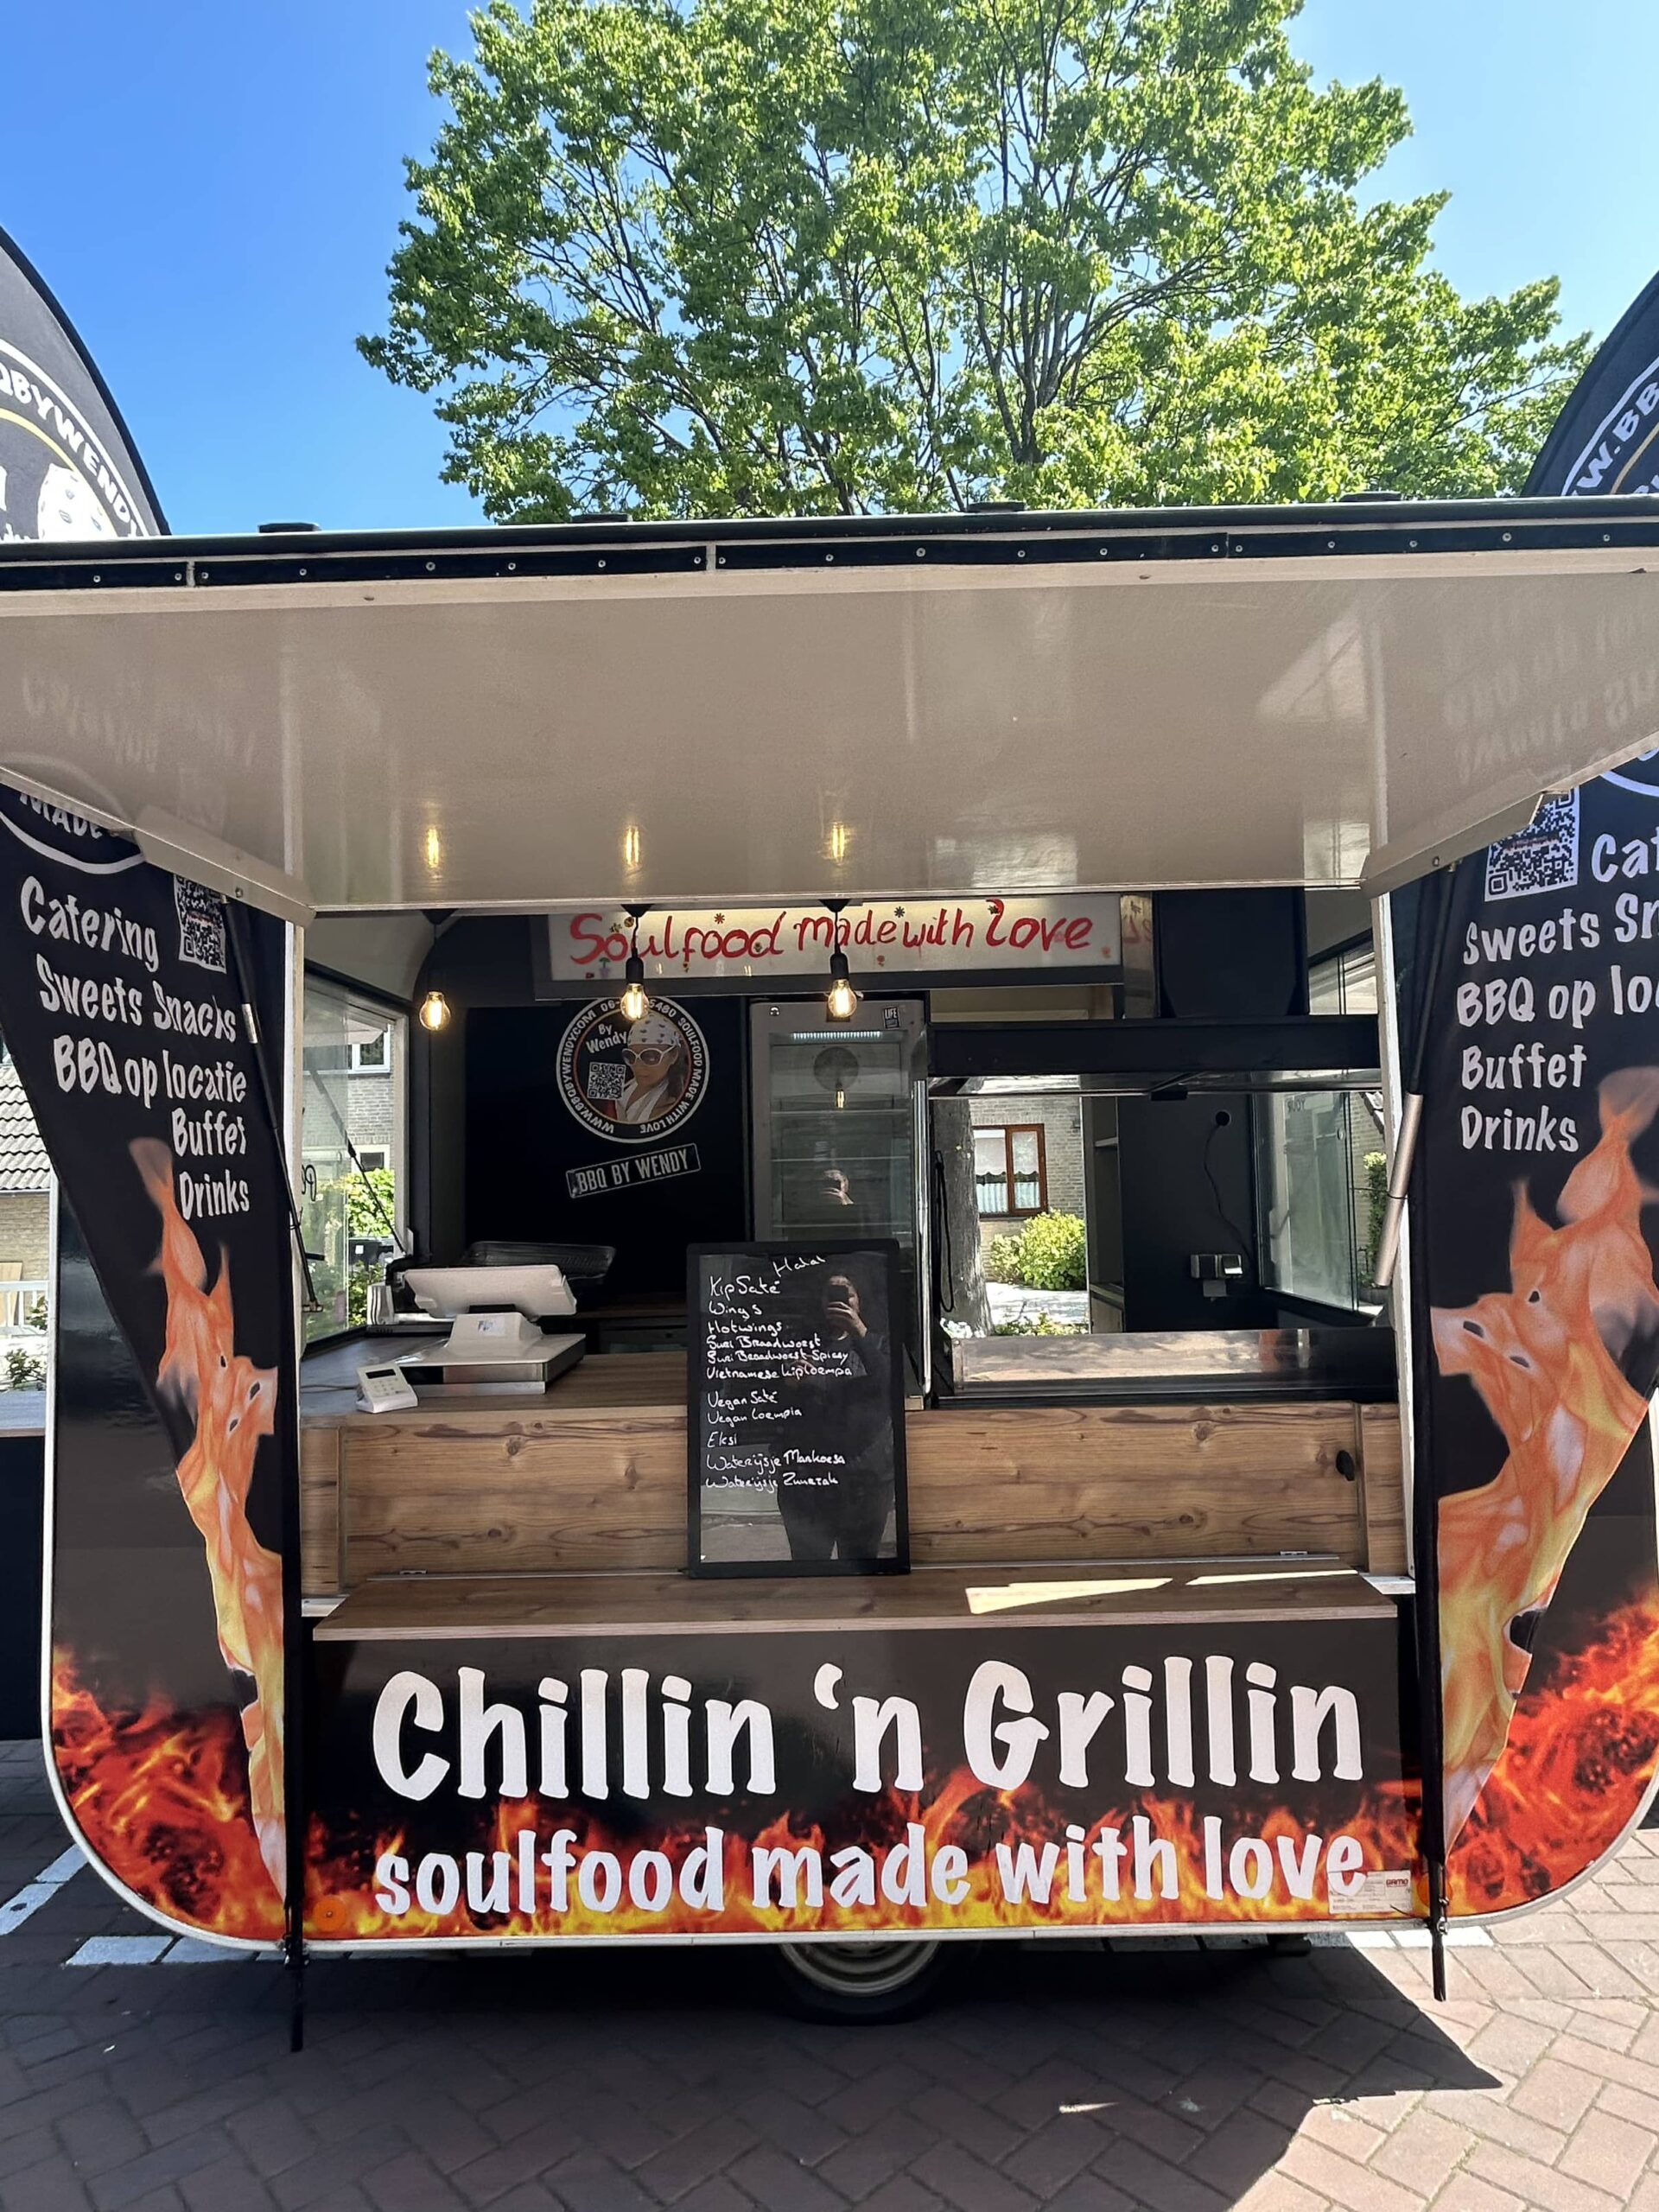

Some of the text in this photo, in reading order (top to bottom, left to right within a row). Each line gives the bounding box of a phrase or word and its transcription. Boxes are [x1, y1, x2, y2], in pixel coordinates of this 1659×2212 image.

[21, 875, 159, 973] Catering
[903, 907, 974, 949] with
[1462, 907, 1600, 965] Sweets
[36, 953, 143, 1027] Sweets
[1457, 976, 1536, 1027] BBQ
[1548, 980, 1597, 1029] op
[586, 1031, 627, 1054] Wendy
[597, 1022, 613, 1036] By
[54, 1034, 247, 1109] BBQ op locatie
[1461, 1041, 1587, 1090] Buffet
[171, 1107, 247, 1157] Buffet
[1460, 1104, 1580, 1152] Drinks
[576, 1147, 690, 1192] BBQ BY WENDY
[179, 1168, 250, 1221] Drinks
[708, 1319, 782, 1337] Hotwings
[707, 1390, 747, 1410] Vegan
[707, 1412, 747, 1427] Vegan
[372, 1666, 776, 1801] Chillin
[963, 1655, 1363, 1790] Grillin
[375, 1815, 1367, 1916] soulfood made with love
